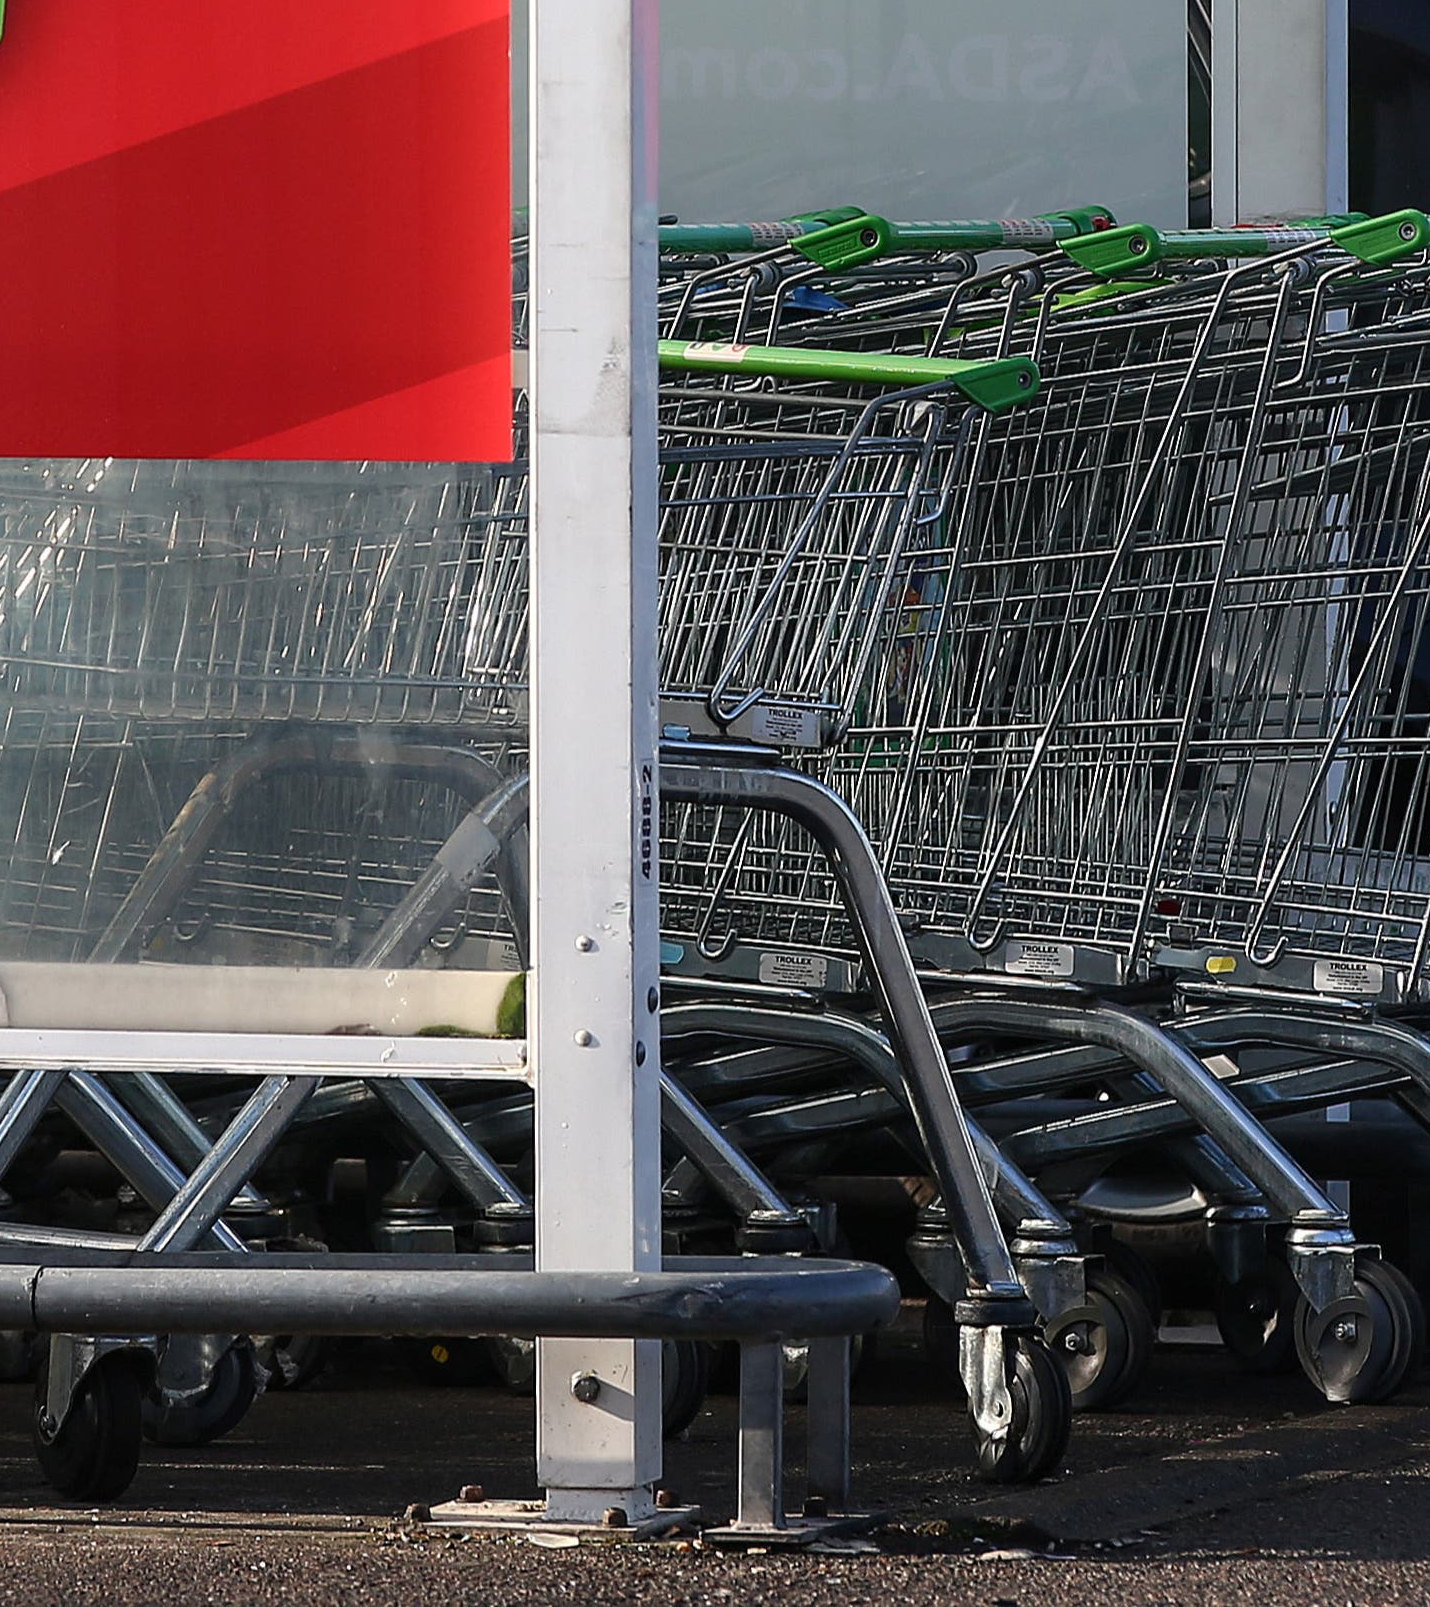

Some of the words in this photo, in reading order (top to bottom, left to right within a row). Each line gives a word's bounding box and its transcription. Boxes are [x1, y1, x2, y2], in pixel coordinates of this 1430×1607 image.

[1021, 944, 1059, 954] TROLLEX
[775, 955, 812, 965] TROLLEX
[1329, 962, 1368, 971] TROLLEX
